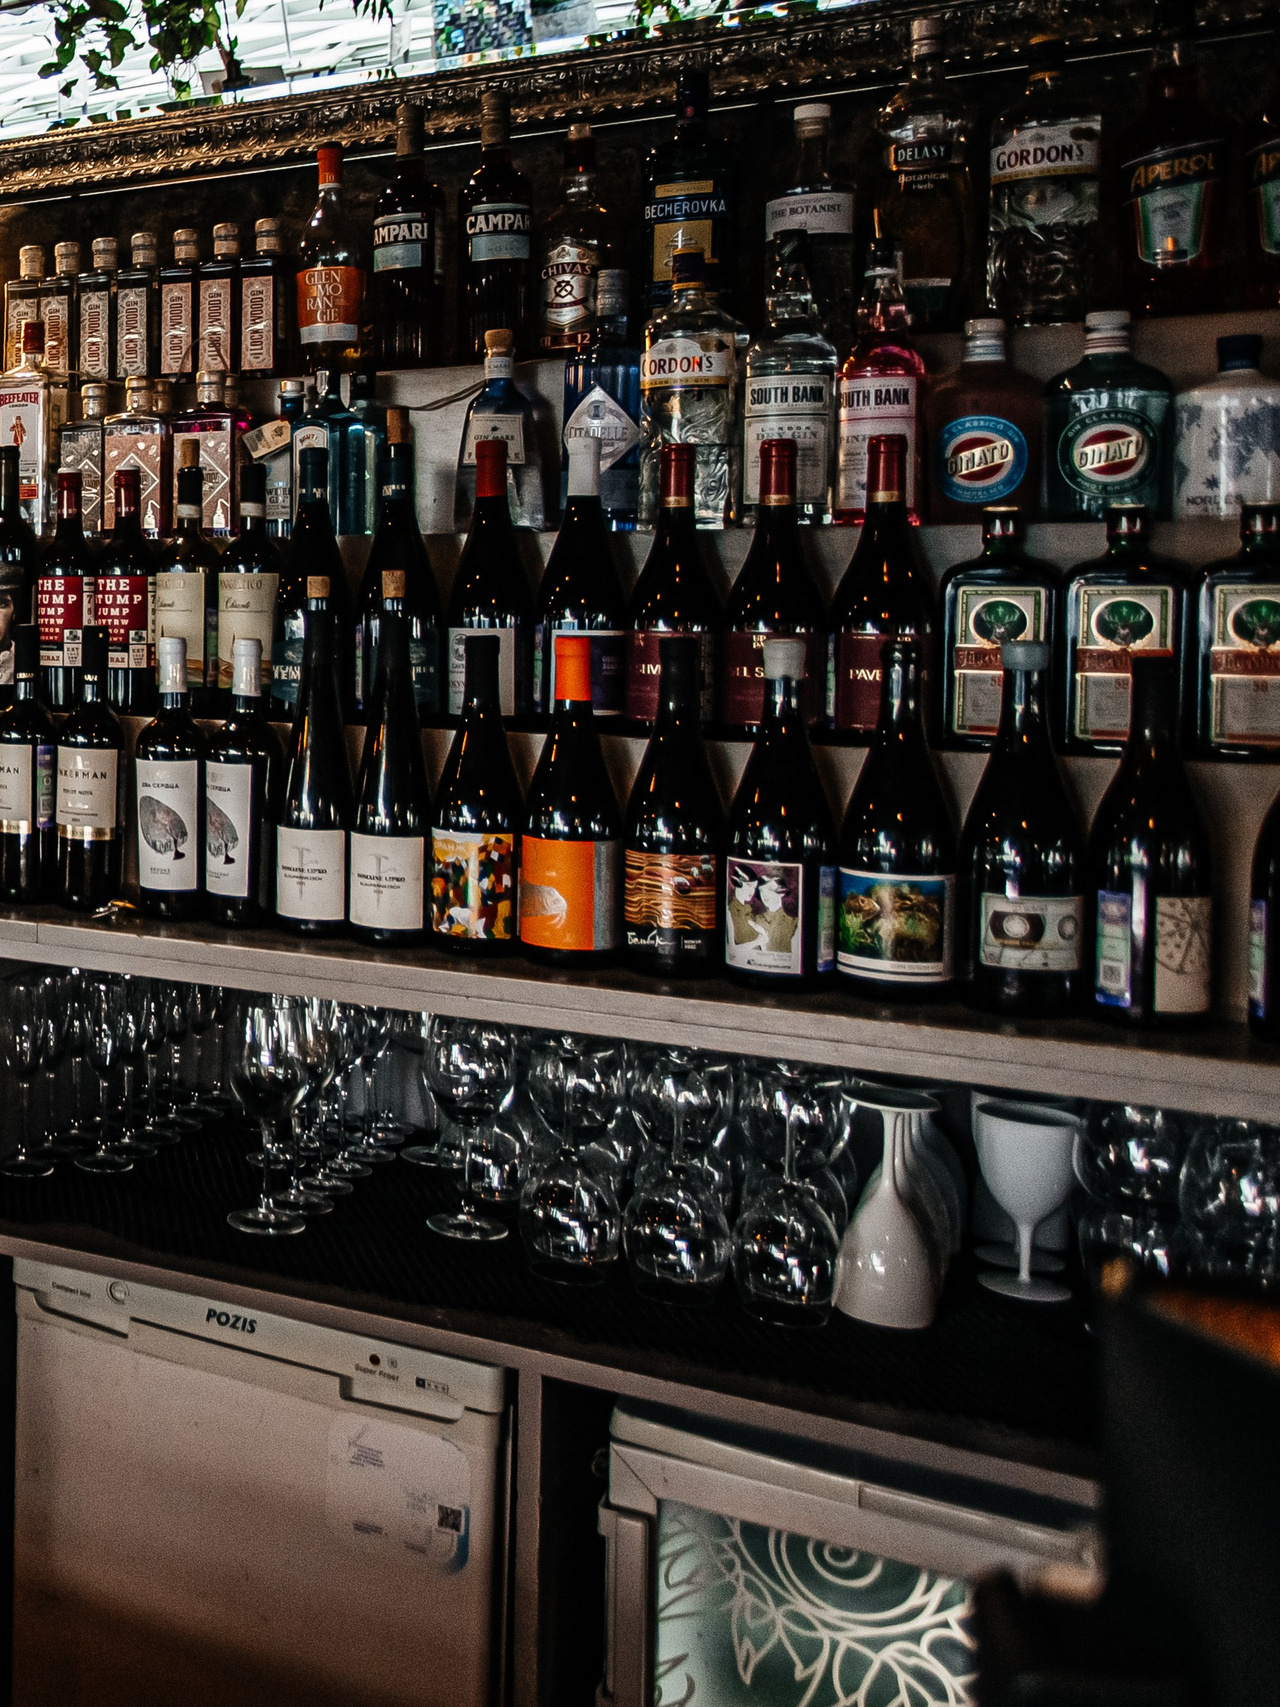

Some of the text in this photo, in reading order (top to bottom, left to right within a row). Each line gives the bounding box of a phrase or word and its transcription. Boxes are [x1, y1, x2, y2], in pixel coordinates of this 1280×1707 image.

[897, 145, 946, 162] DELASY
[996, 143, 1084, 172] GORDON'S
[1131, 153, 1215, 193] APEROL
[645, 199, 726, 220] BECHEROVKA
[789, 203, 842, 218] BOTANIST
[466, 212, 531, 236] CAMPAR
[374, 222, 428, 247] AMPARI
[305, 270, 342, 285] GLEN
[541, 263, 592, 280] CHIVAS
[317, 283, 342, 297] MO
[307, 297, 334, 311] RAN
[316, 308, 339, 322] GIE
[577, 332, 591, 345] 12
[0, 391, 39, 407] BEEFEATER
[750, 385, 826, 405] SOUTH BANK
[874, 387, 910, 406] BANK
[1086, 411, 1141, 425] CLASSICO
[474, 433, 516, 442] GIN MARE
[756, 431, 818, 441] DRY GIN
[947, 439, 1011, 476] GINATO
[1078, 435, 1145, 470] GINATO
[98, 579, 130, 591] THE
[38, 594, 77, 605] TUMP
[95, 594, 142, 605] TUMP
[38, 607, 65, 616] UMP
[109, 656, 126, 664] RAZ
[849, 668, 883, 682] PAVE
[58, 768, 108, 780] NKERMAN
[51, 1281, 79, 1297] Compact
[205, 1307, 258, 1335] POZIS
[378, 1369, 399, 1383] Frost
